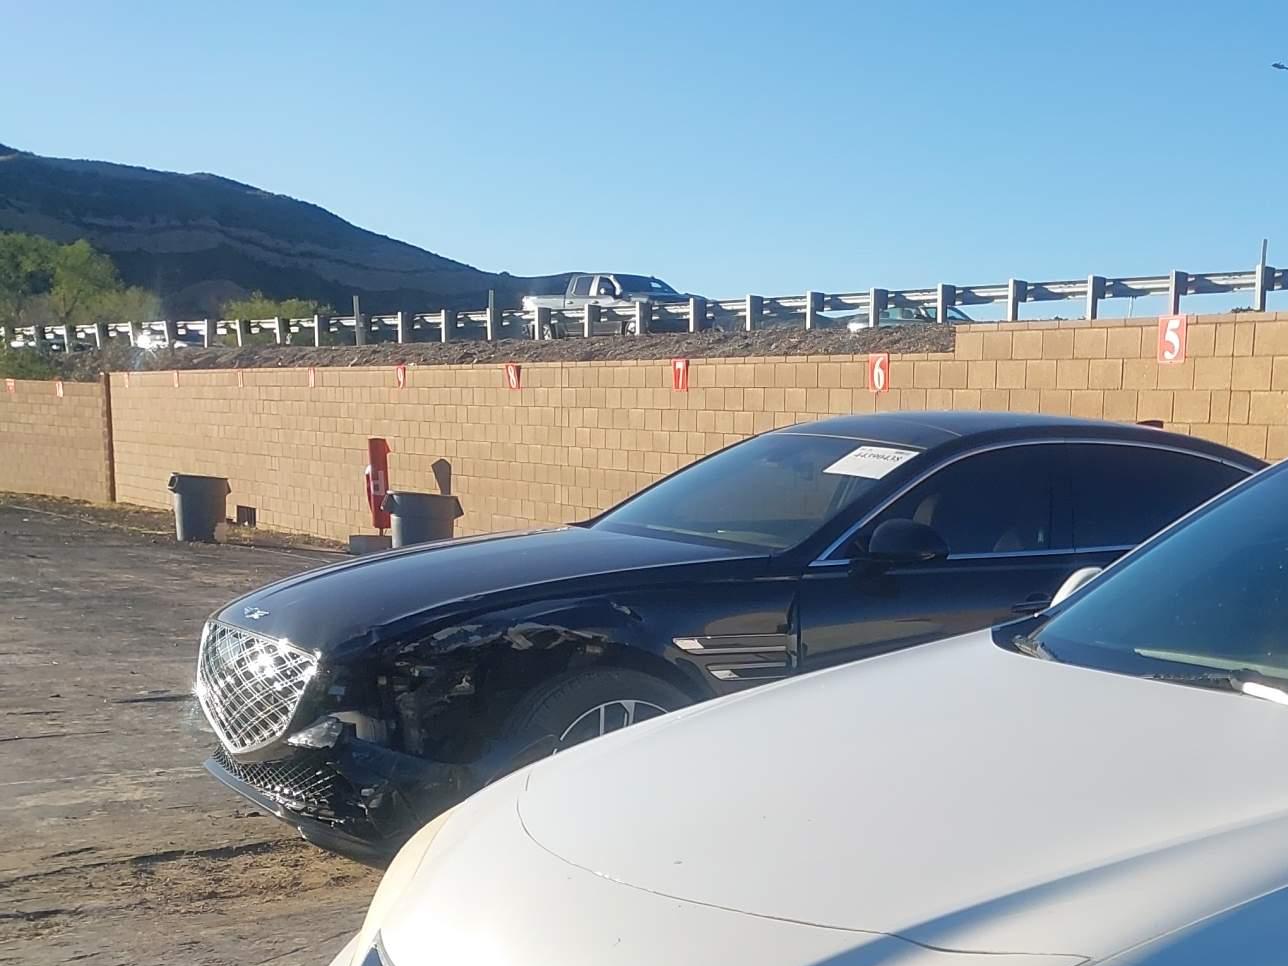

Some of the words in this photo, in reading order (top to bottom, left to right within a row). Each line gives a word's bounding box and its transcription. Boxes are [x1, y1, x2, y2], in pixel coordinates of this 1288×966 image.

[1164, 319, 1181, 360] 5
[507, 365, 517, 388] 8
[675, 361, 685, 389] 7
[873, 356, 885, 390] 6
